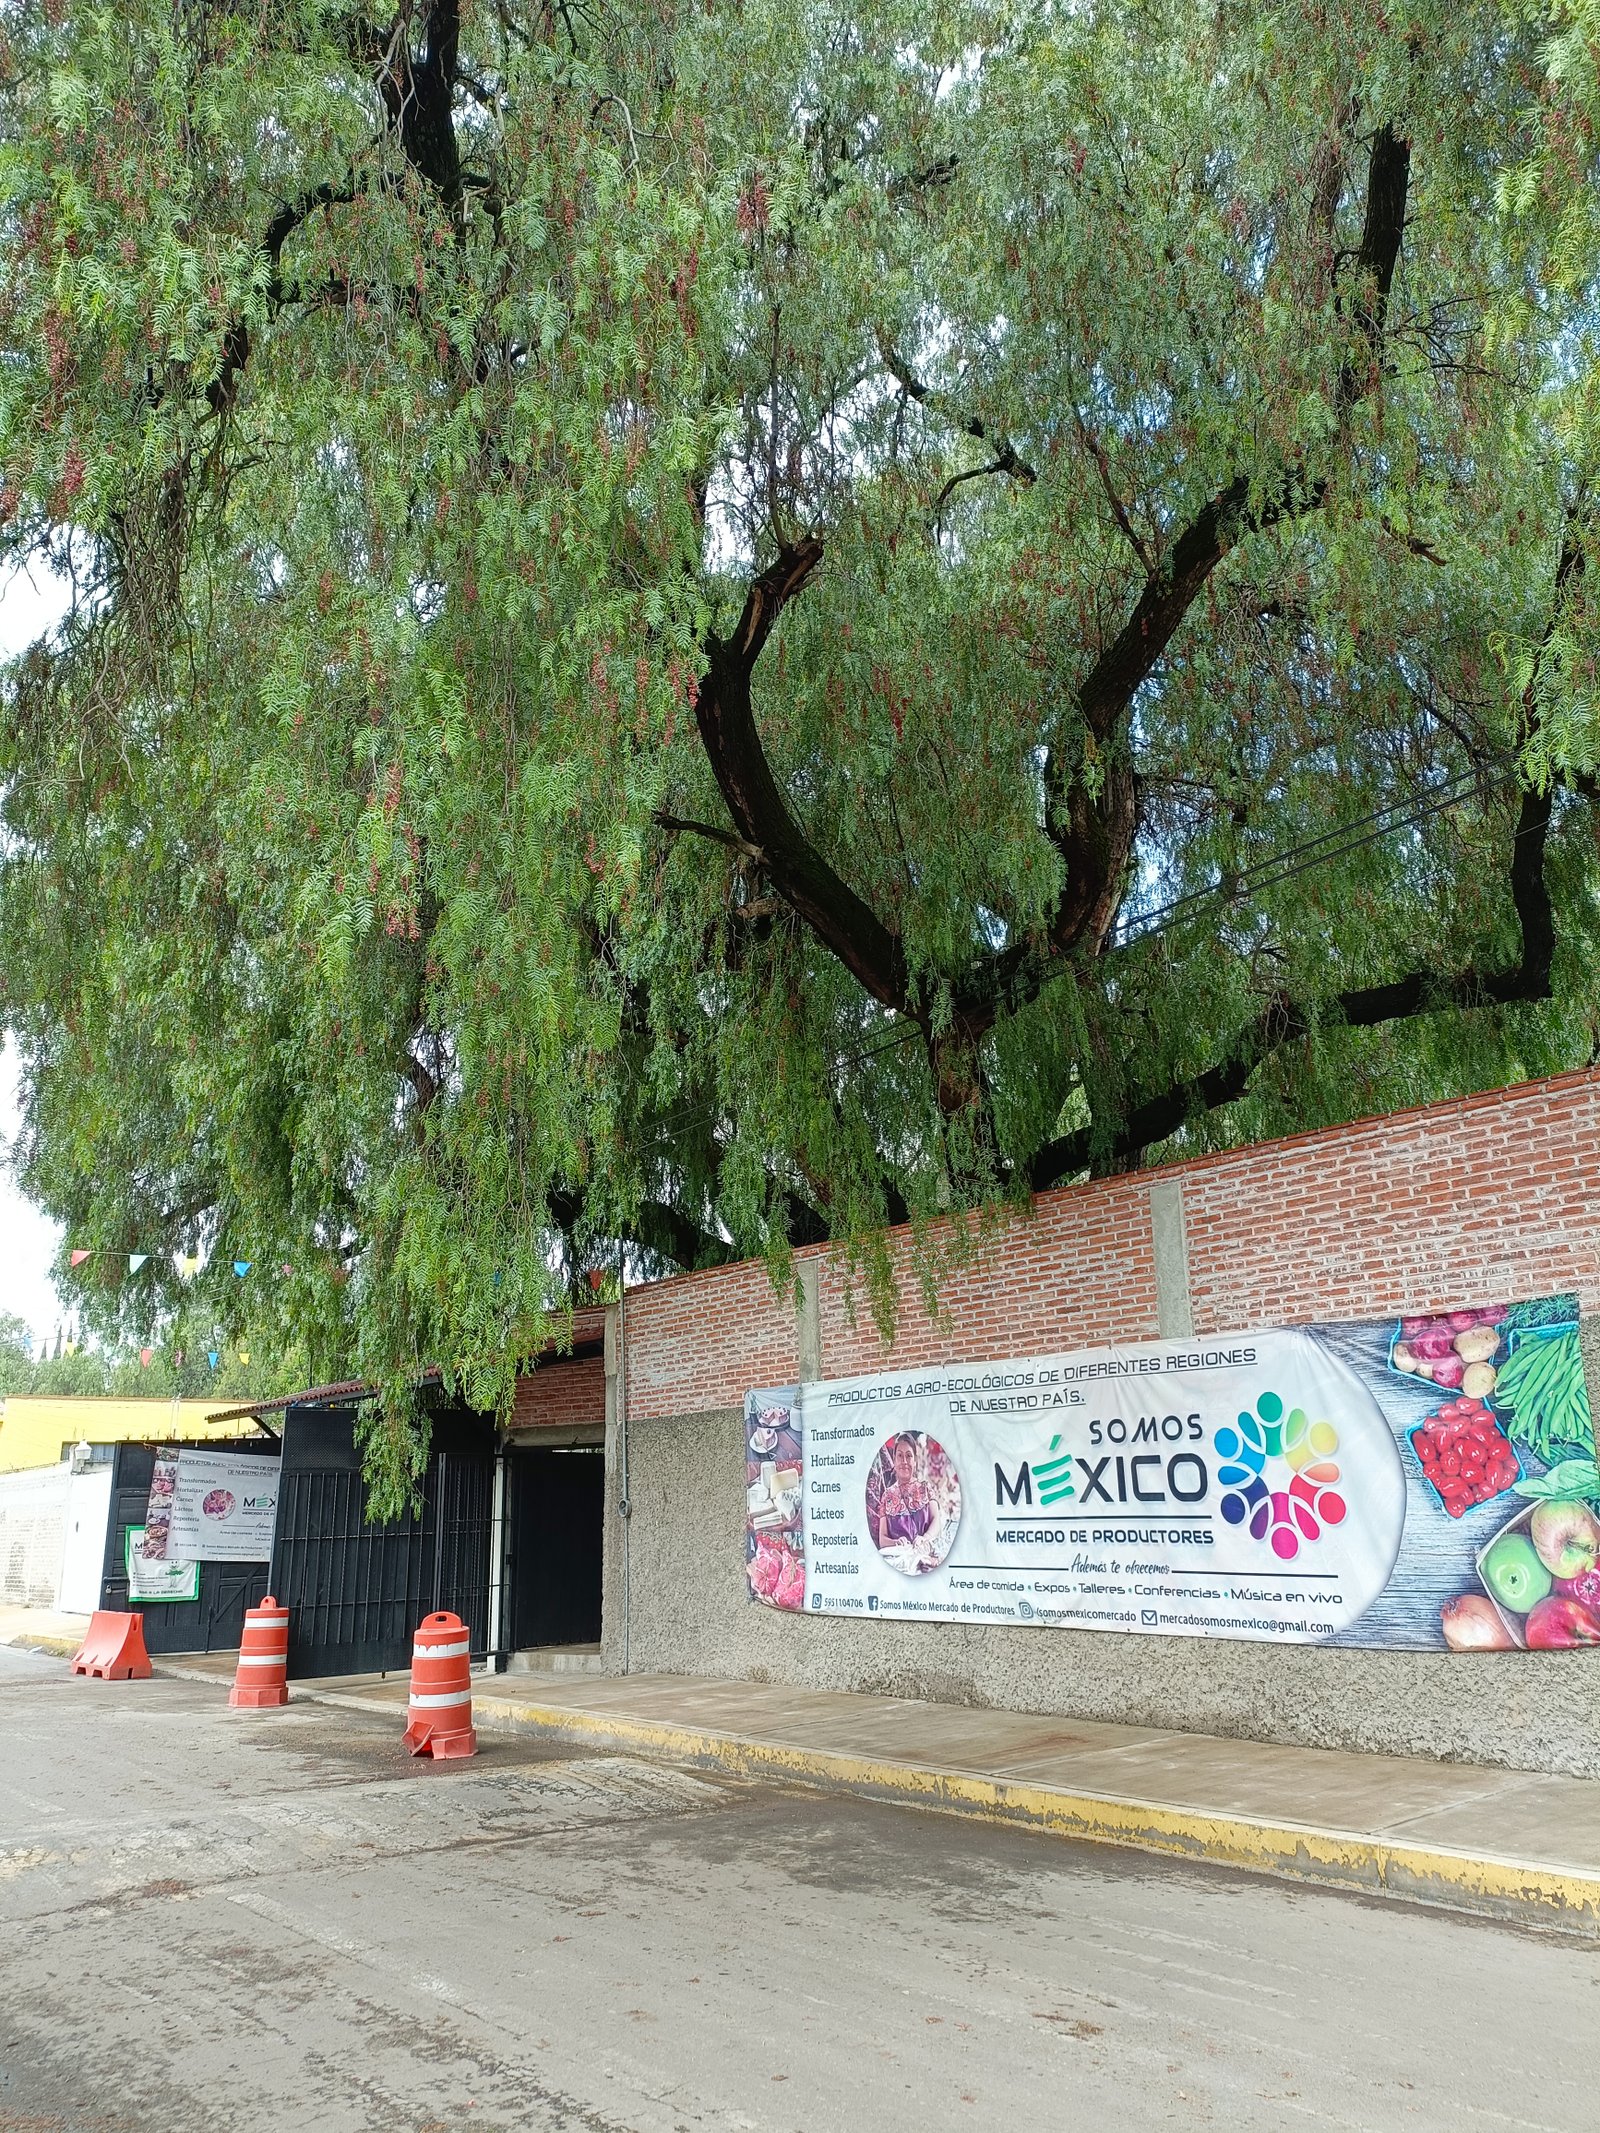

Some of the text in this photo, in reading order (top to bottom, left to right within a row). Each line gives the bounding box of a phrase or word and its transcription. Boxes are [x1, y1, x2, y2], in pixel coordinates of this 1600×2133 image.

[828, 1348, 1256, 1404] PRODUCTOS AGRO-ECOLÓGICOS DE DIFERENTES REGIONES
[950, 1387, 1085, 1413] DE NUESTRO PAÍS.
[811, 1424, 875, 1441] Transformados
[1089, 1413, 1203, 1445] SOMOS
[811, 1453, 855, 1467] Hortalizas
[994, 1434, 1208, 1506] MÉXICO
[811, 1481, 841, 1493] Carnes
[811, 1507, 845, 1520] Lácteos
[811, 1532, 858, 1548] Repostería
[996, 1529, 1214, 1544] MERCADO DE PRODUCTORES
[814, 1561, 859, 1574] Artesanías
[1071, 1552, 1107, 1574] Además
[1110, 1559, 1120, 1574] te
[949, 1576, 1343, 1604] Área de comida Expos Talleres Conferencias Música en vivo
[880, 1600, 901, 1610] Somos
[903, 1601, 928, 1611] México
[929, 1602, 959, 1613] Mercado
[961, 1602, 971, 1613] de
[972, 1603, 1015, 1616] Productores
[1159, 1612, 1335, 1634] mercadosomosmexico@gmail.com
